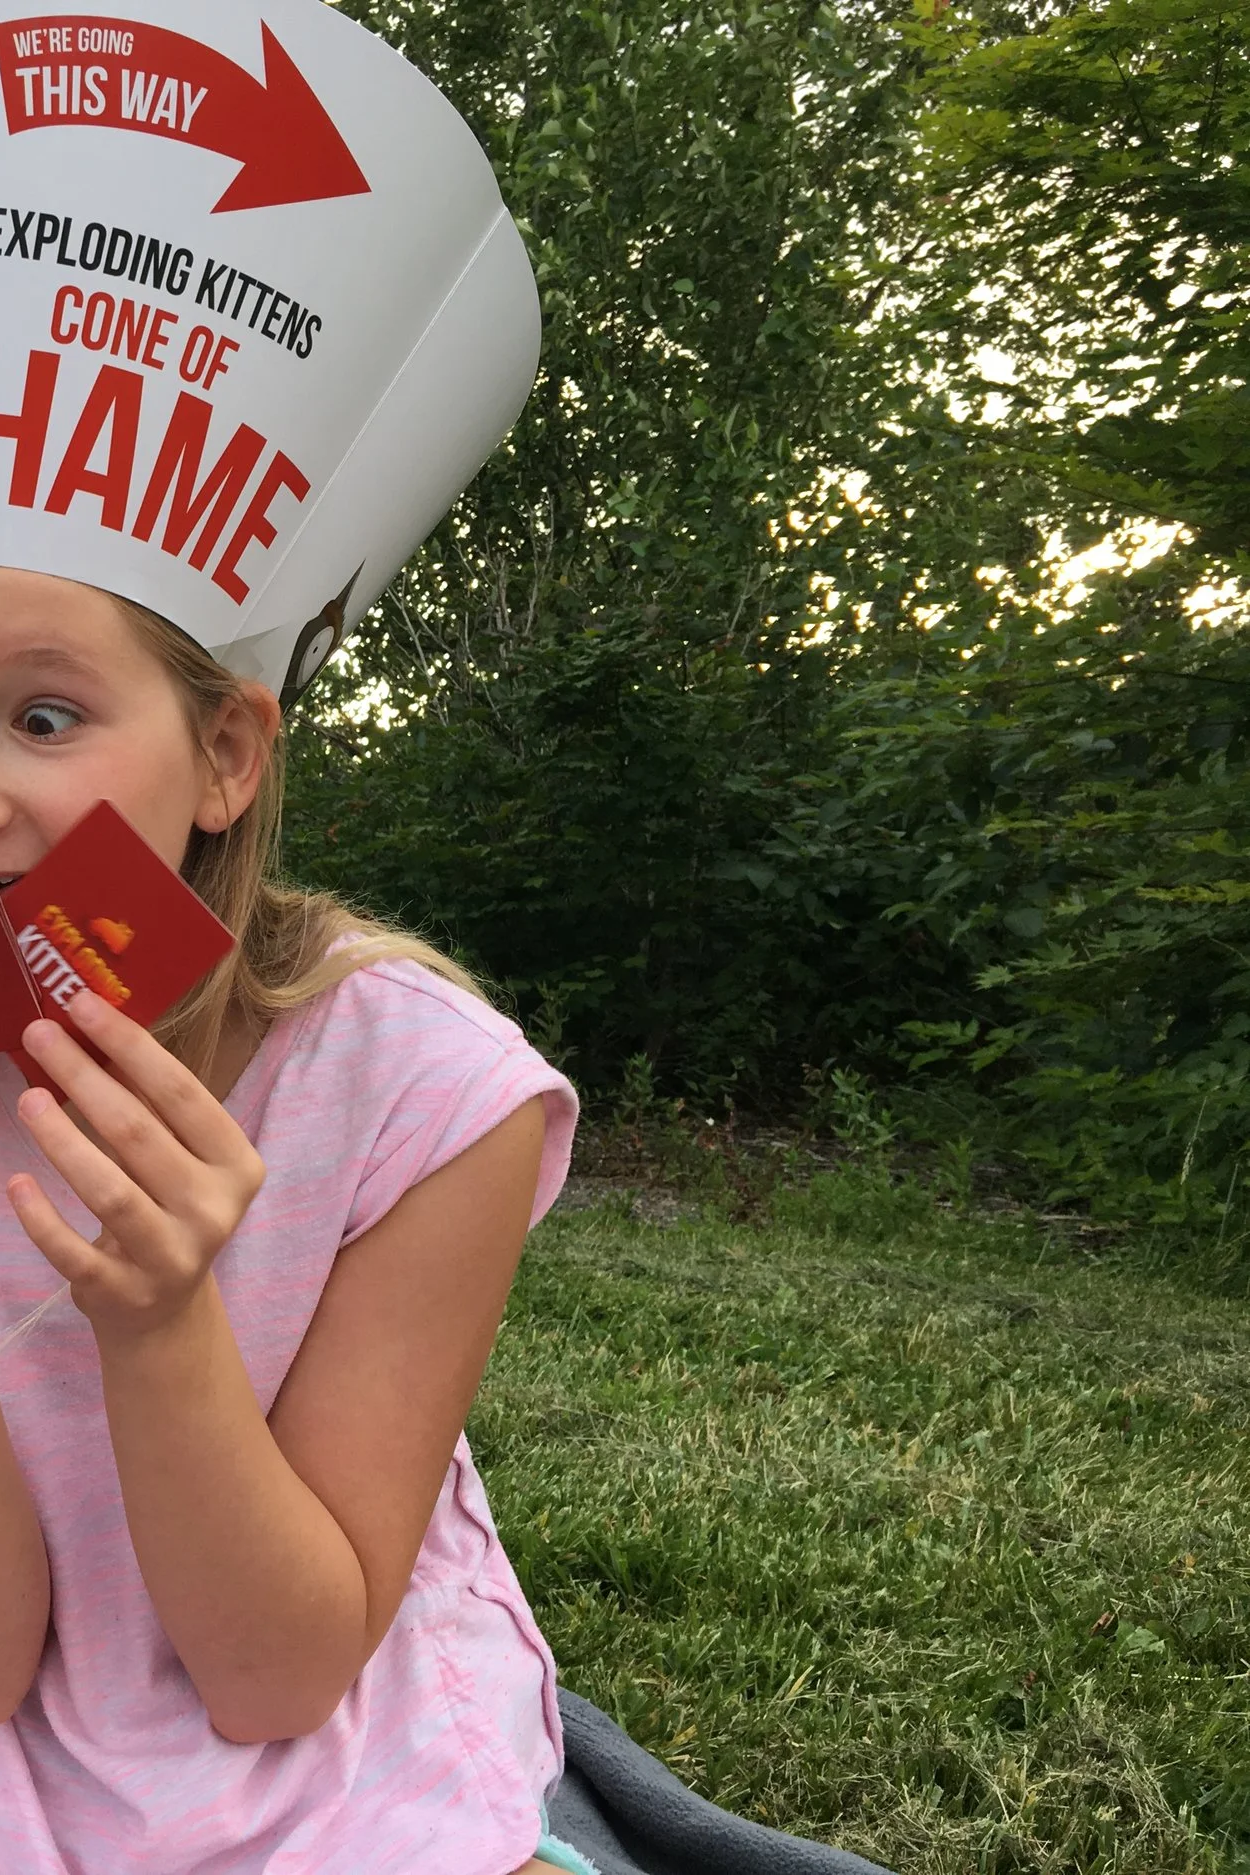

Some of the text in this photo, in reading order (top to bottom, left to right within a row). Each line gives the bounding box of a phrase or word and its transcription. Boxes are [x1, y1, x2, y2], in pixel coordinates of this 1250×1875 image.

[13, 27, 134, 58] WE'RE GOING
[15, 65, 208, 133] THIS WAY
[50, 285, 240, 390] CONE OF
[195, 258, 322, 359] KITTENS
[17, 924, 87, 1012] KITTE
